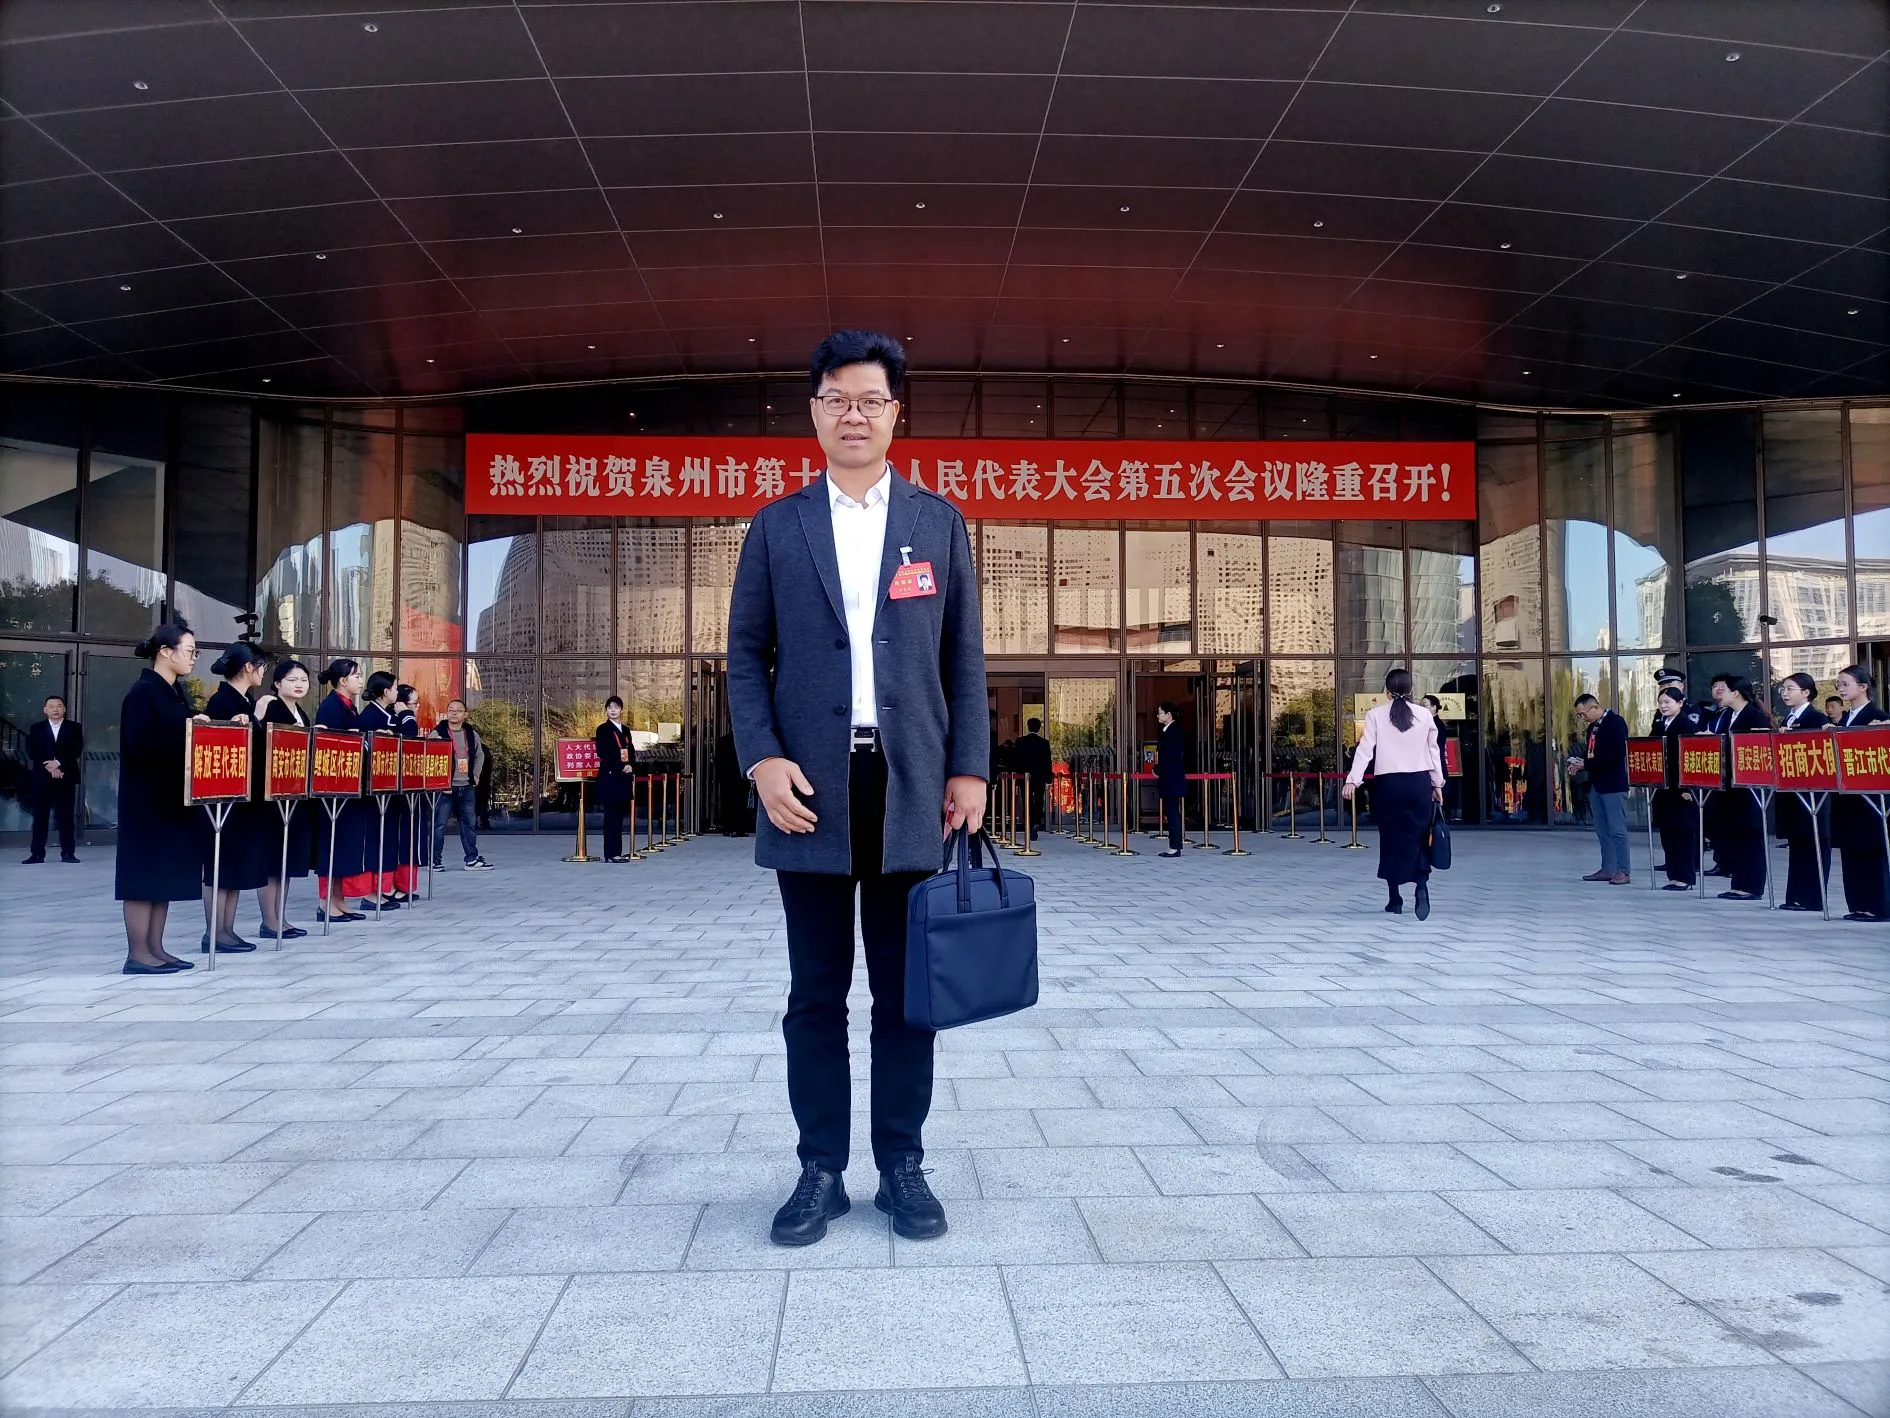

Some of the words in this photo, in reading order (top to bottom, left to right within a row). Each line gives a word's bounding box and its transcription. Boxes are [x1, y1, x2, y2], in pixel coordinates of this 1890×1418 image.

[489, 455, 1451, 502] 热烈祝贺泉州市第十人民代表大会第五次会议隆重召开!
[194, 744, 247, 779] 解放军代表团
[1843, 746, 1890, 777] 晋江市代
